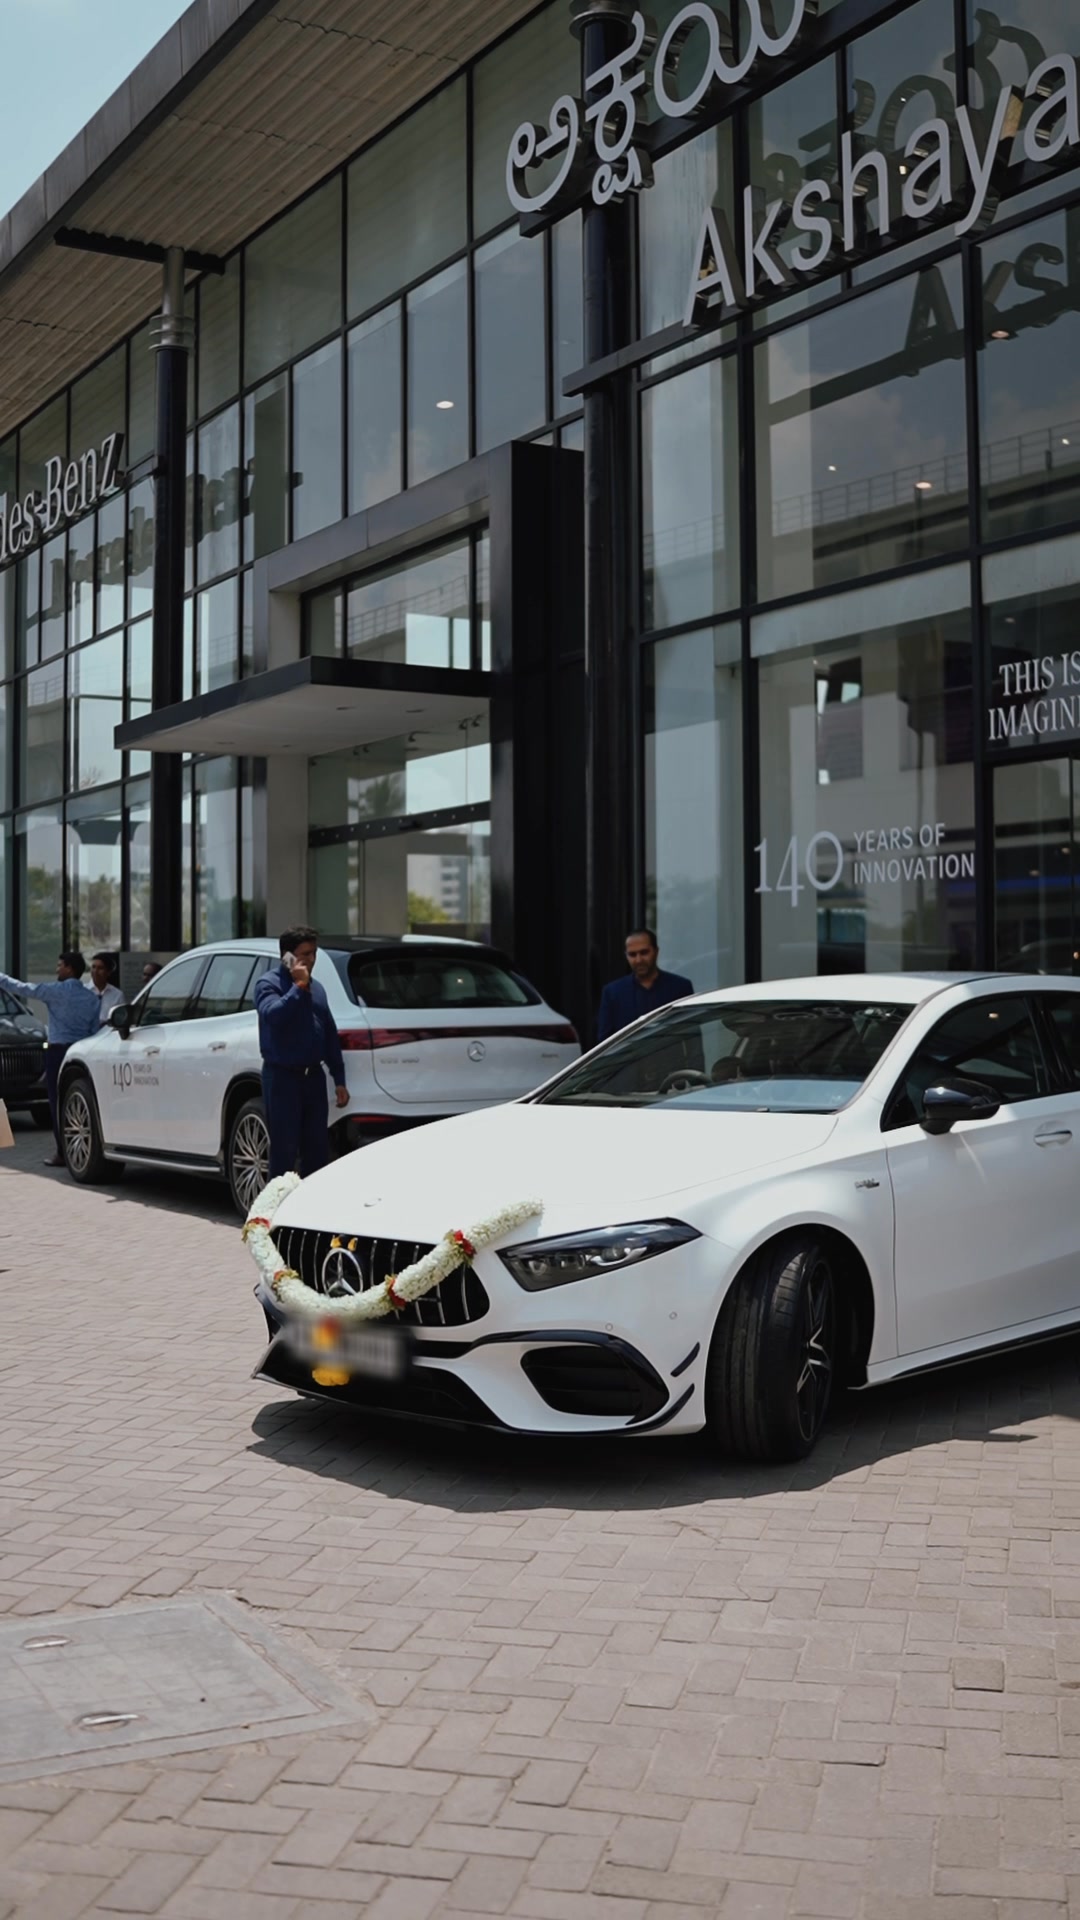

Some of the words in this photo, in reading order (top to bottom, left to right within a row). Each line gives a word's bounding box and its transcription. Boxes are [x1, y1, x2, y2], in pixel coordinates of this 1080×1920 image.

[684, 53, 1080, 327] Akshaya
[999, 656, 1055, 696] THIS
[1061, 651, 1080, 686] IS
[988, 695, 1080, 741] IMAGIN
[853, 826, 913, 853] YEARS
[919, 823, 945, 848] OF
[754, 831, 843, 907] 140
[853, 853, 975, 884] INNOVATION
[112, 1062, 132, 1092] 140
